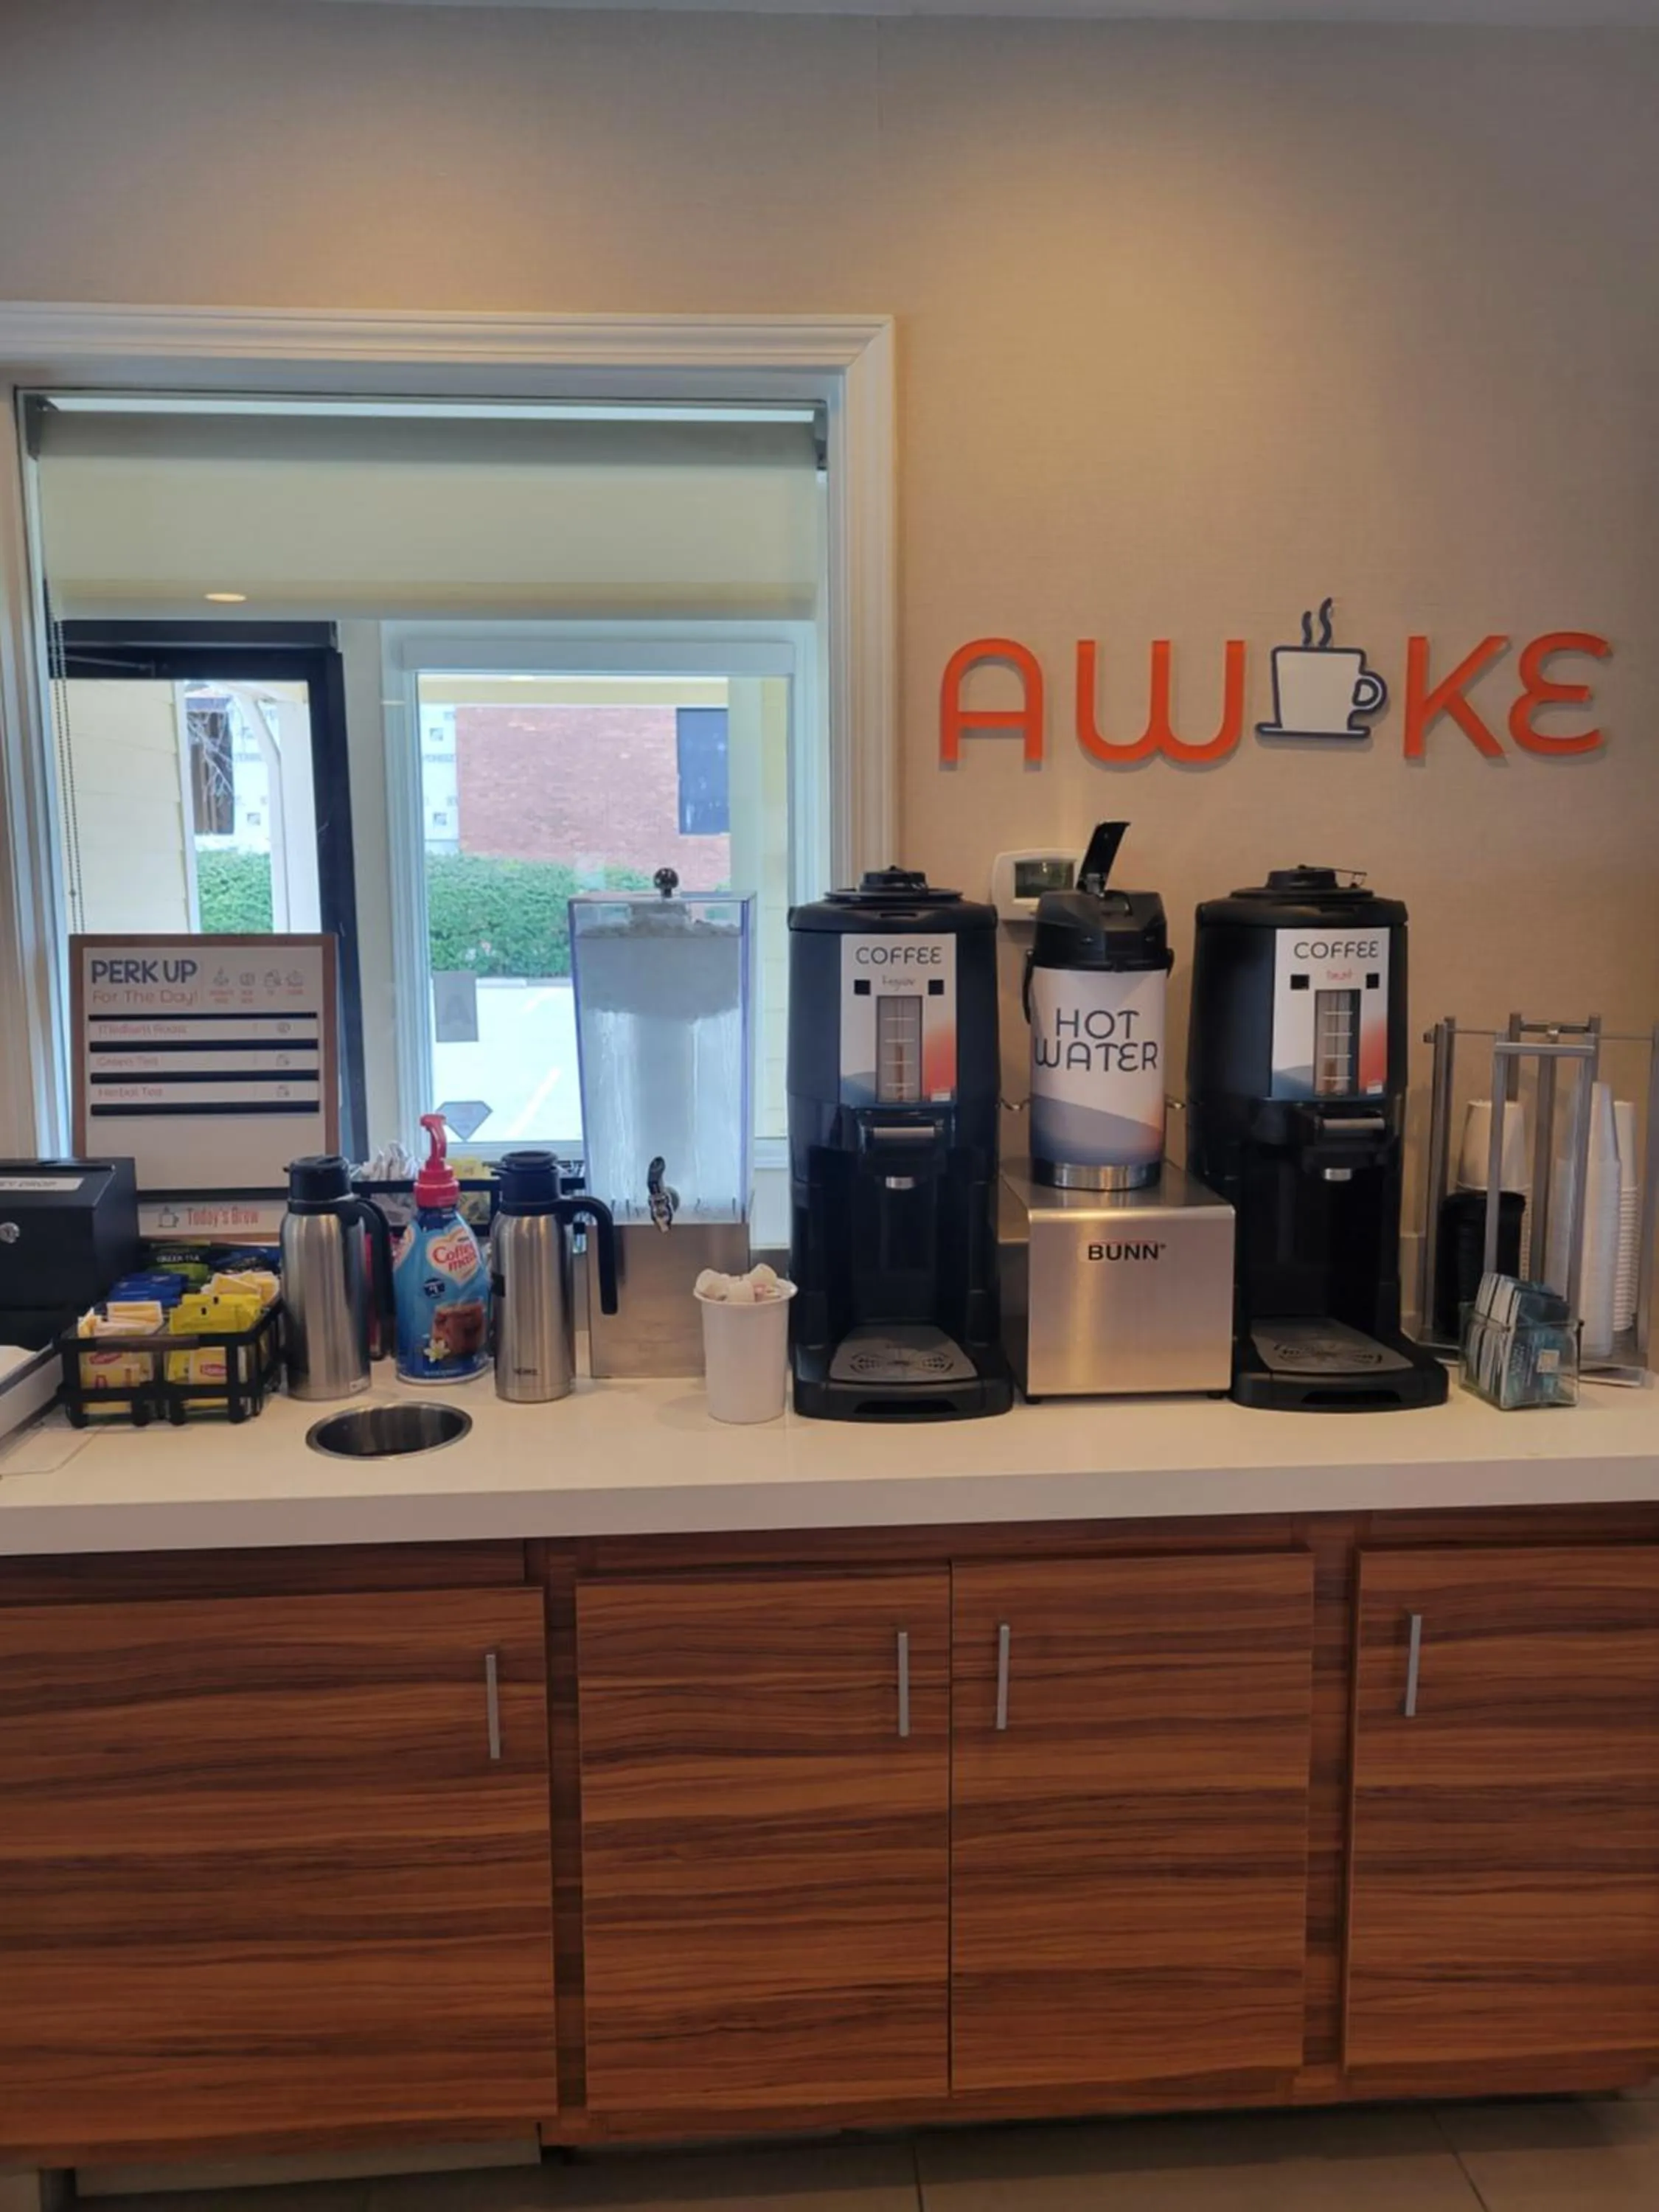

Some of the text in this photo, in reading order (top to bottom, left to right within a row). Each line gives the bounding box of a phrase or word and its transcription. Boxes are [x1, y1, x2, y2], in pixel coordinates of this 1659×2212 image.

[939, 631, 1612, 764] AWKE
[856, 947, 942, 964] COFFEE
[1294, 941, 1379, 959] COFFEE
[91, 959, 198, 984] PERK UP
[93, 990, 116, 1004] For
[125, 990, 154, 1004] The
[1055, 1008, 1140, 1039] HOT
[1034, 1037, 1158, 1071] WATER
[187, 1206, 229, 1227] Today's
